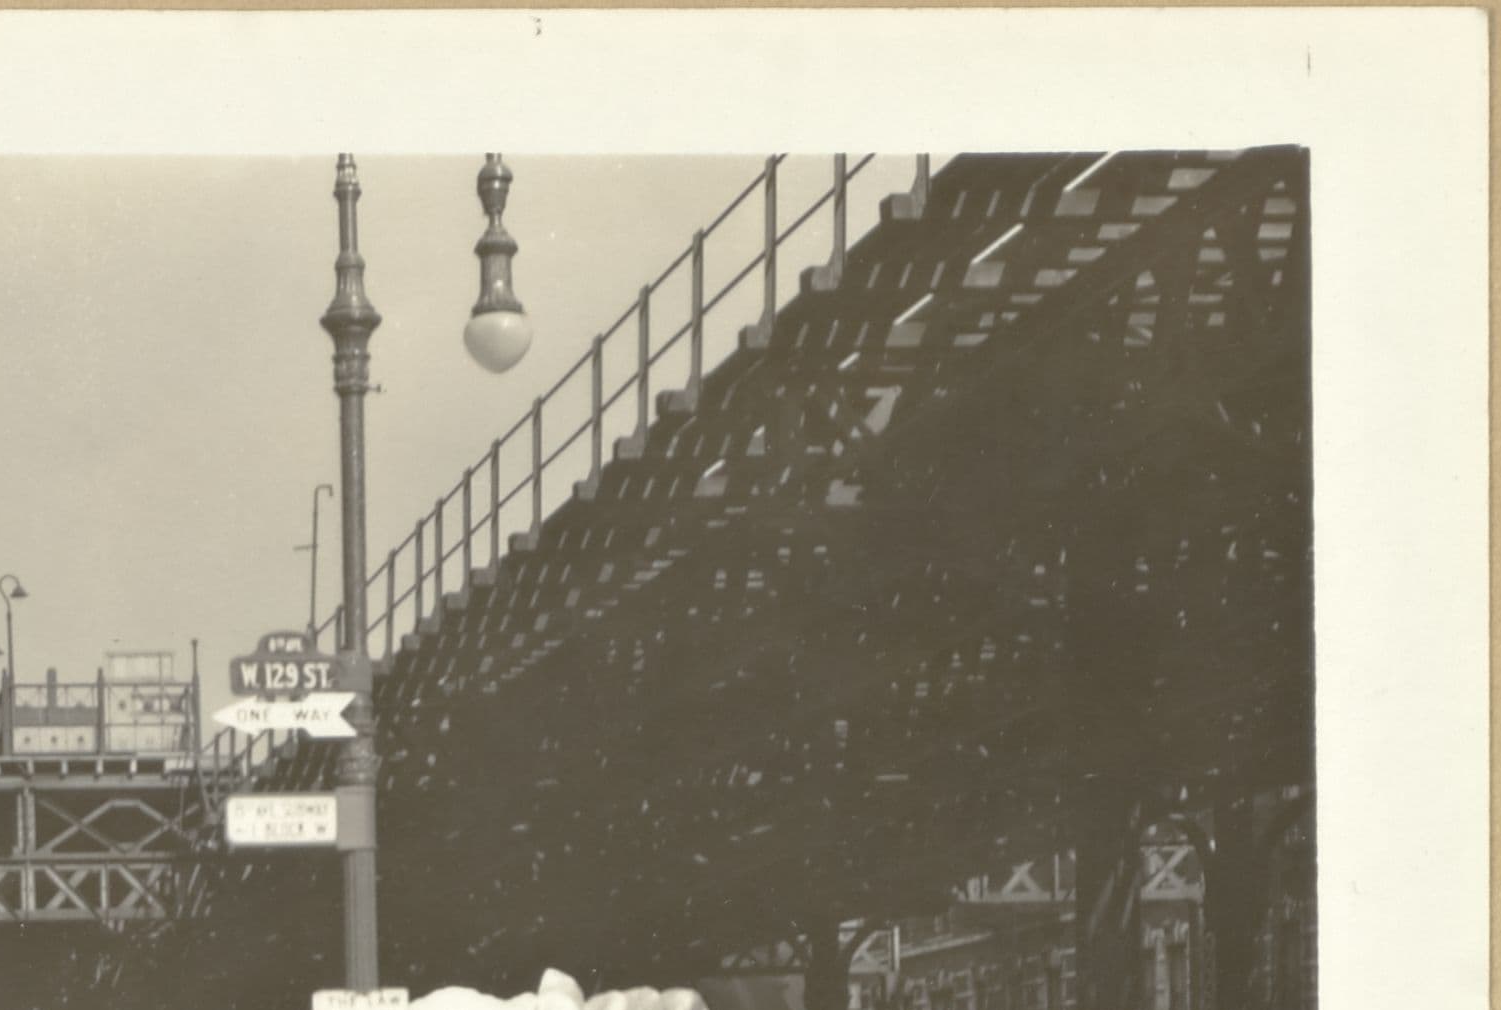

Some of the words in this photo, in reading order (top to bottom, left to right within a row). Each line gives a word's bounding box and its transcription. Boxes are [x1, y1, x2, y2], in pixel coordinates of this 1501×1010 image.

[264, 662, 299, 689] 129
[237, 708, 269, 721] ONE
[294, 708, 329, 721] WAY
